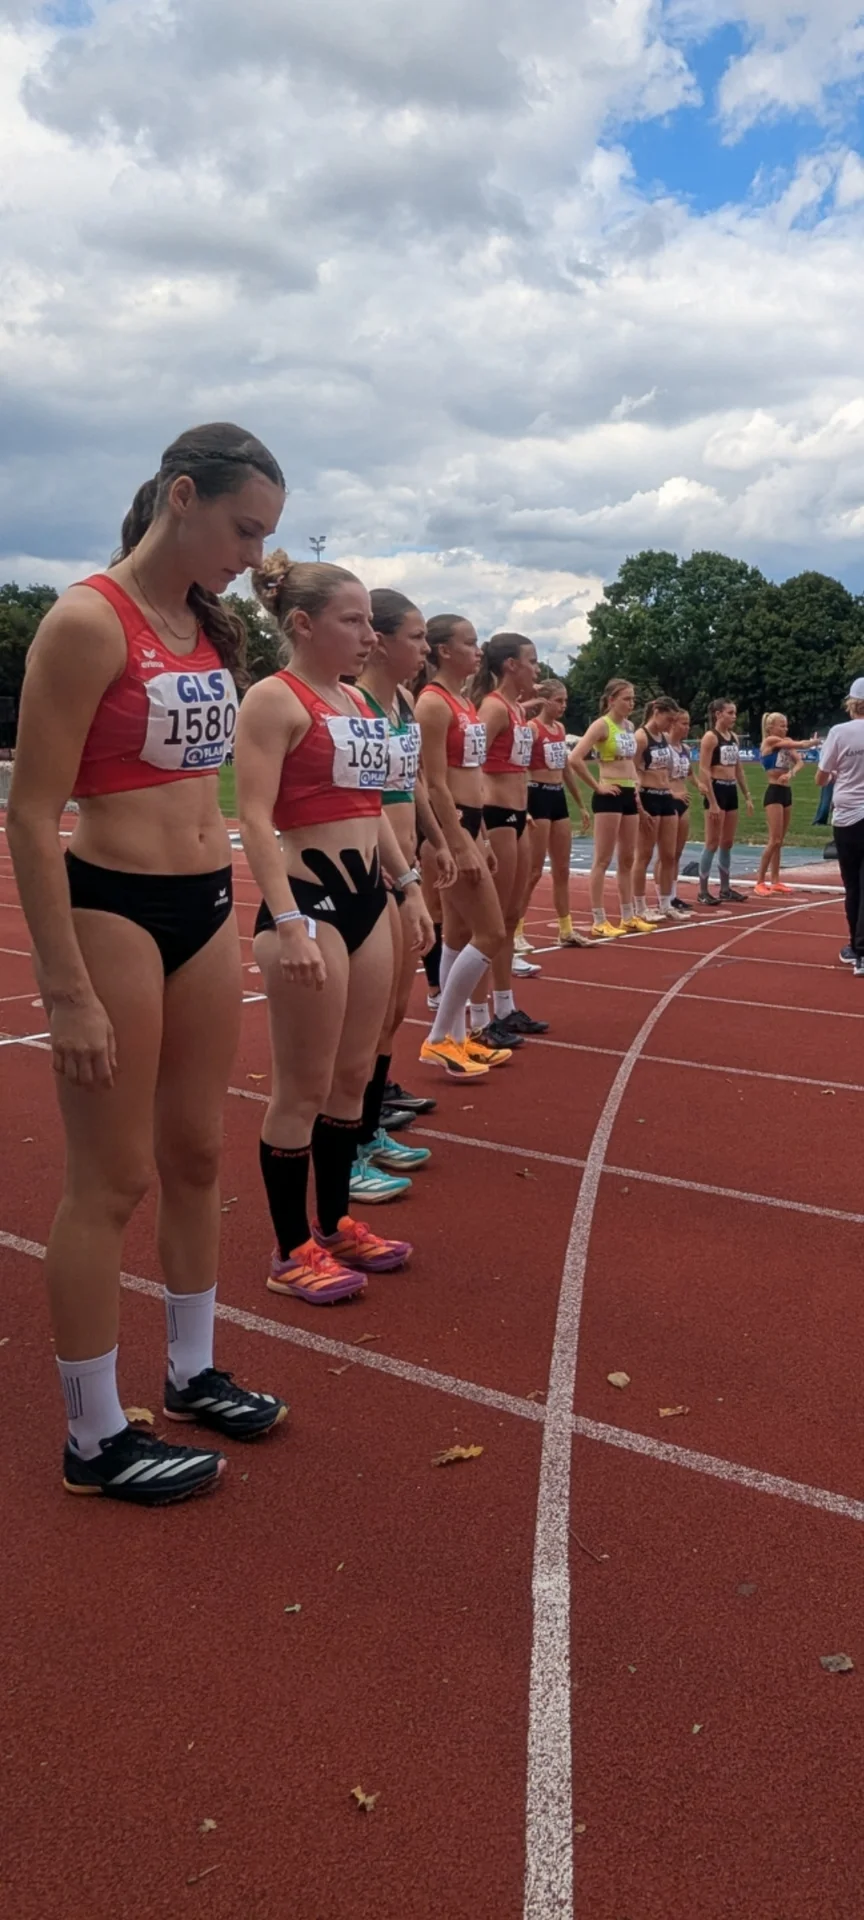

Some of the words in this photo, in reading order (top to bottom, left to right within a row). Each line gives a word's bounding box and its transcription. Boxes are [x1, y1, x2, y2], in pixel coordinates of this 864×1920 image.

[177, 672, 225, 703] GLS
[164, 703, 236, 745] 1580
[349, 718, 386, 740] GLS
